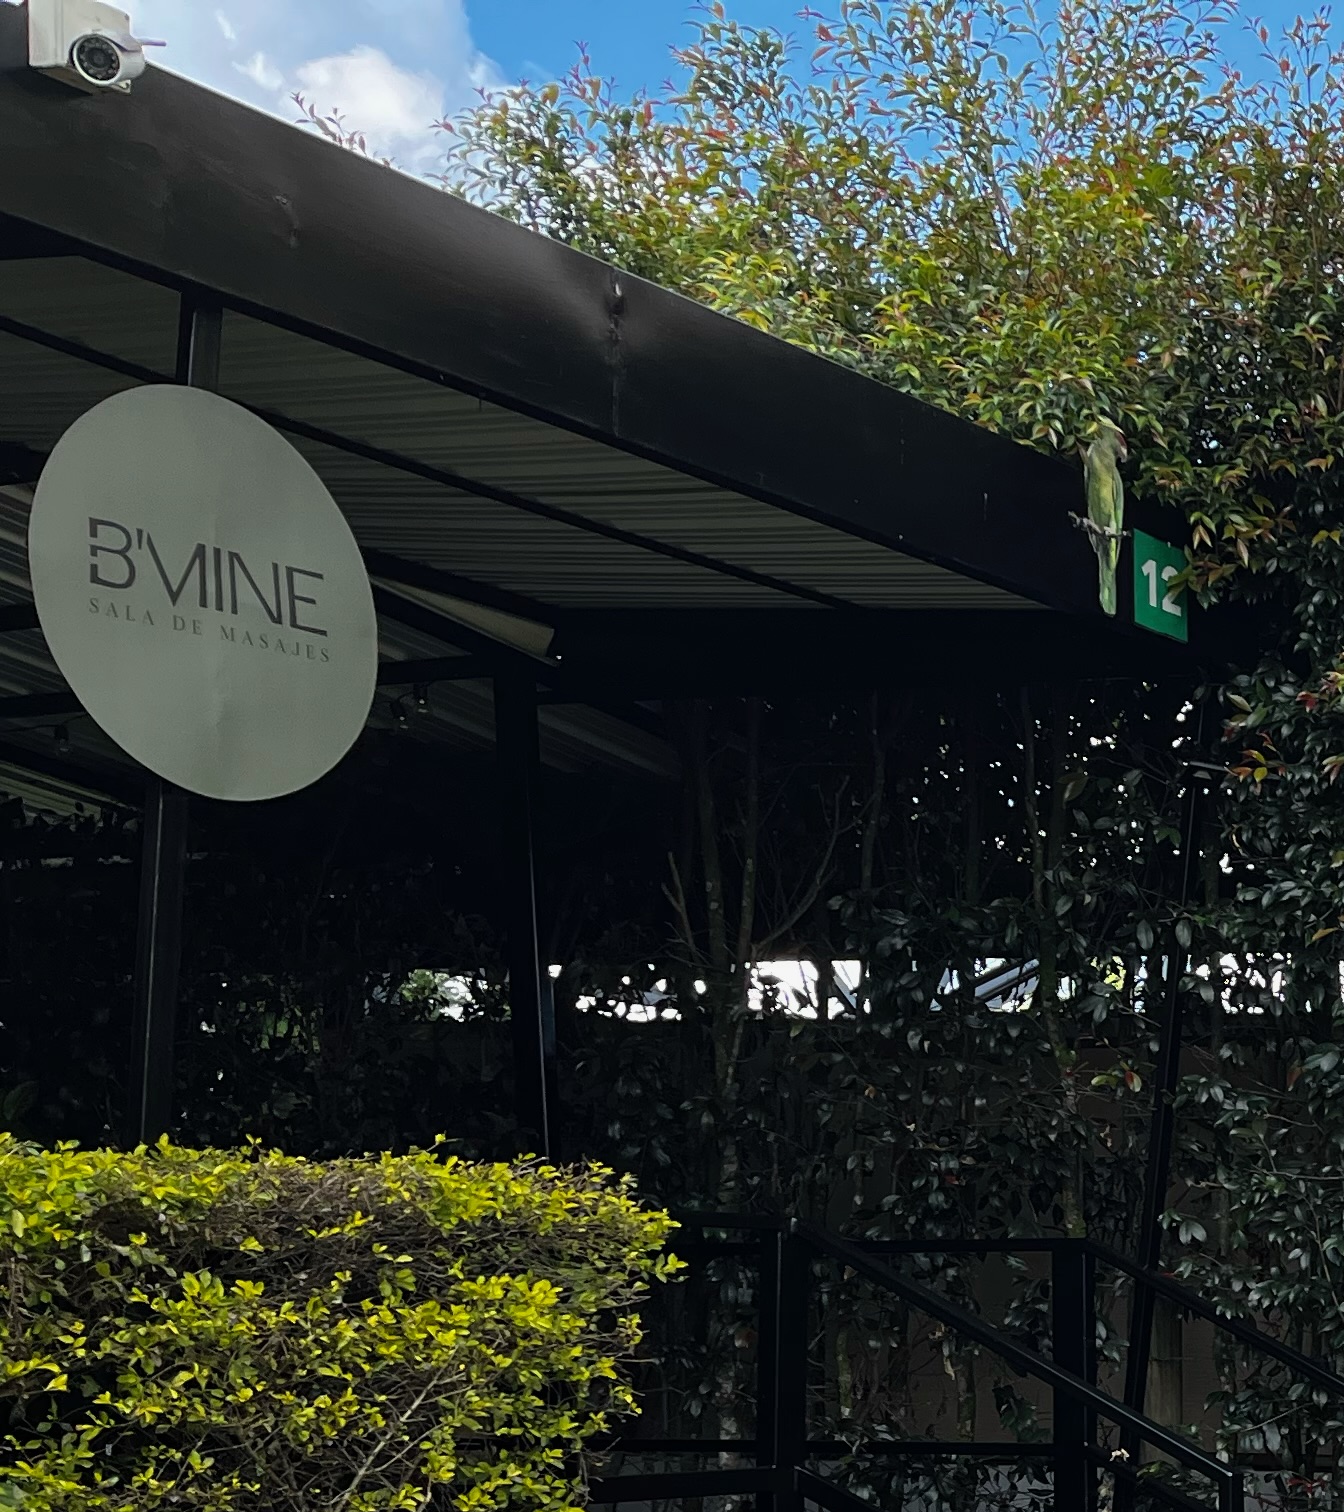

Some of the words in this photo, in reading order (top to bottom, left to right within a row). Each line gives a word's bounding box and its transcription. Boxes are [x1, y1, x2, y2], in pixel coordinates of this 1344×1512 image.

[1141, 559, 1182, 617] 12
[89, 598, 155, 626] SALA
[172, 614, 203, 636] DE
[220, 625, 330, 663] MASAJES
